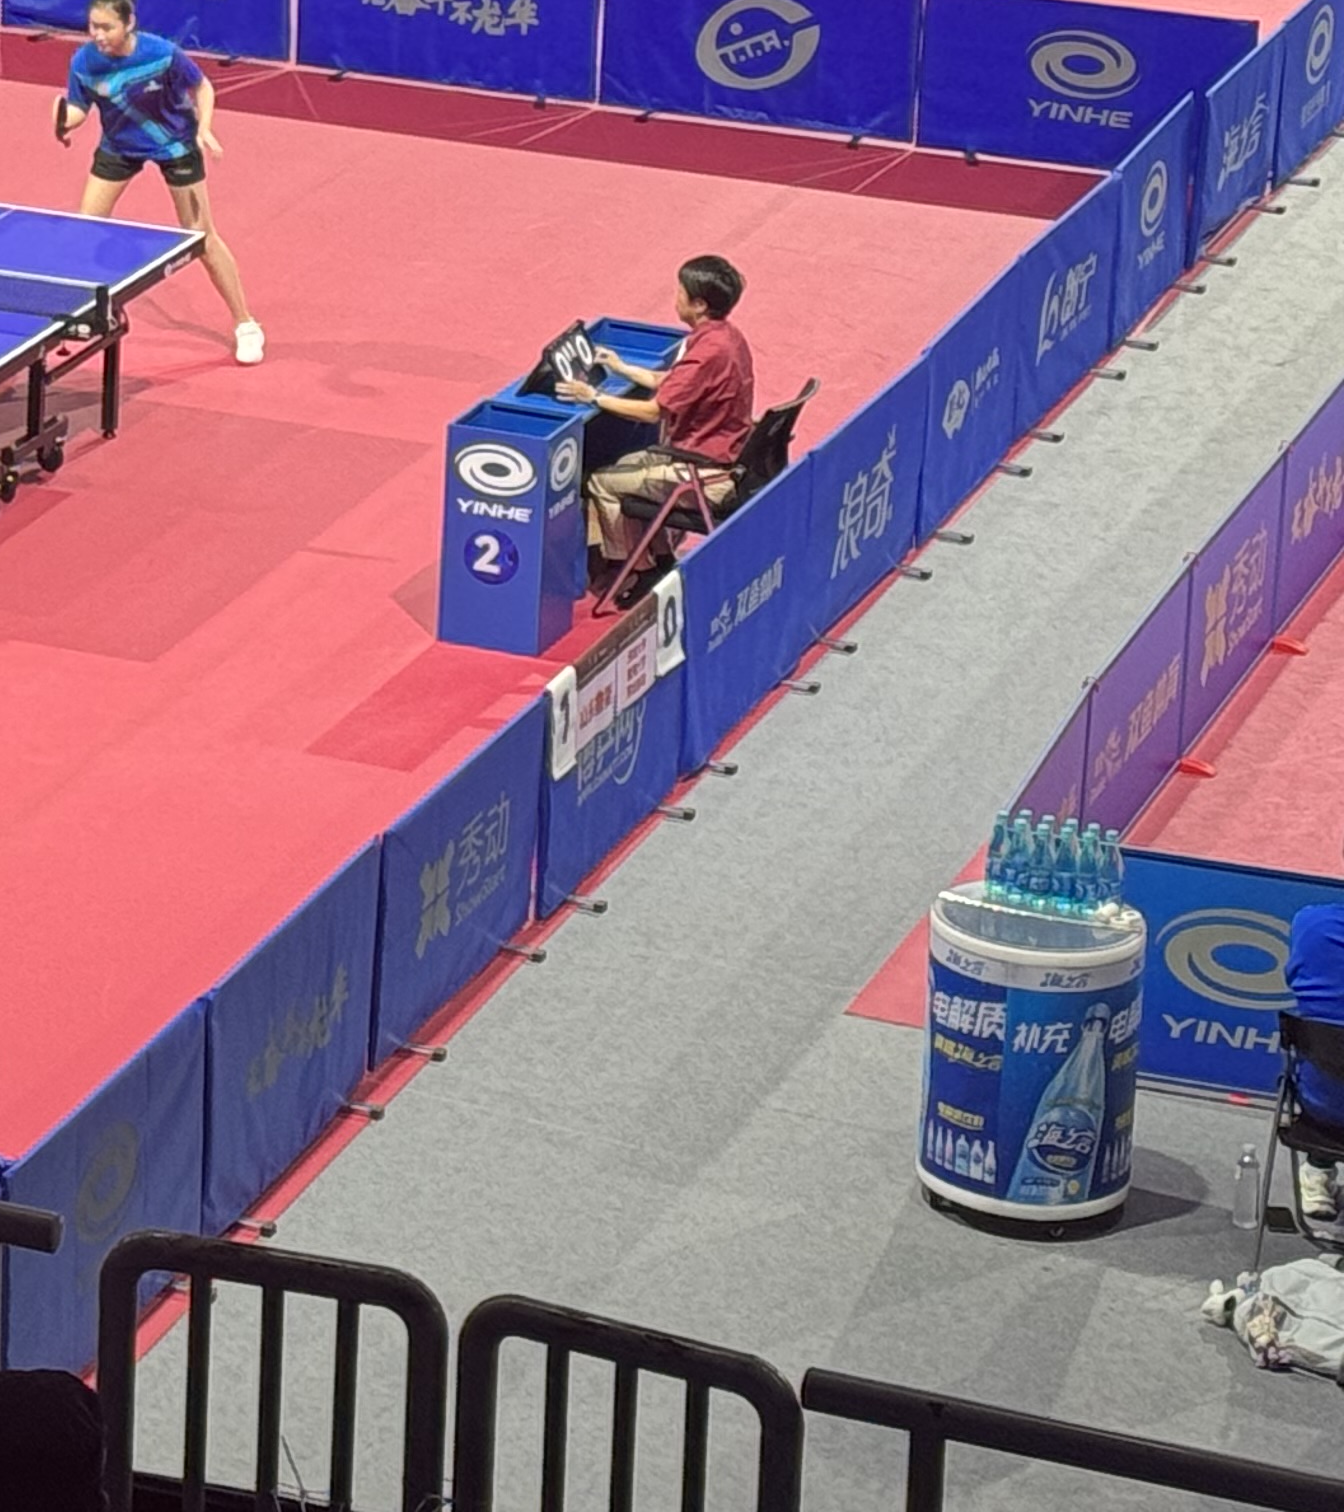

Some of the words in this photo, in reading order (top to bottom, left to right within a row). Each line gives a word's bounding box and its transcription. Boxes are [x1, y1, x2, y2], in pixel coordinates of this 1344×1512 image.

[1027, 96, 1135, 130] YINHE
[574, 333, 593, 365] 0
[456, 497, 534, 524] YINHE
[472, 535, 502, 575] 2
[455, 789, 511, 890] 秀动
[932, 990, 1008, 1042] 电解质
[1161, 1012, 1282, 1056] YINH
[1012, 1021, 1075, 1055] 补充
